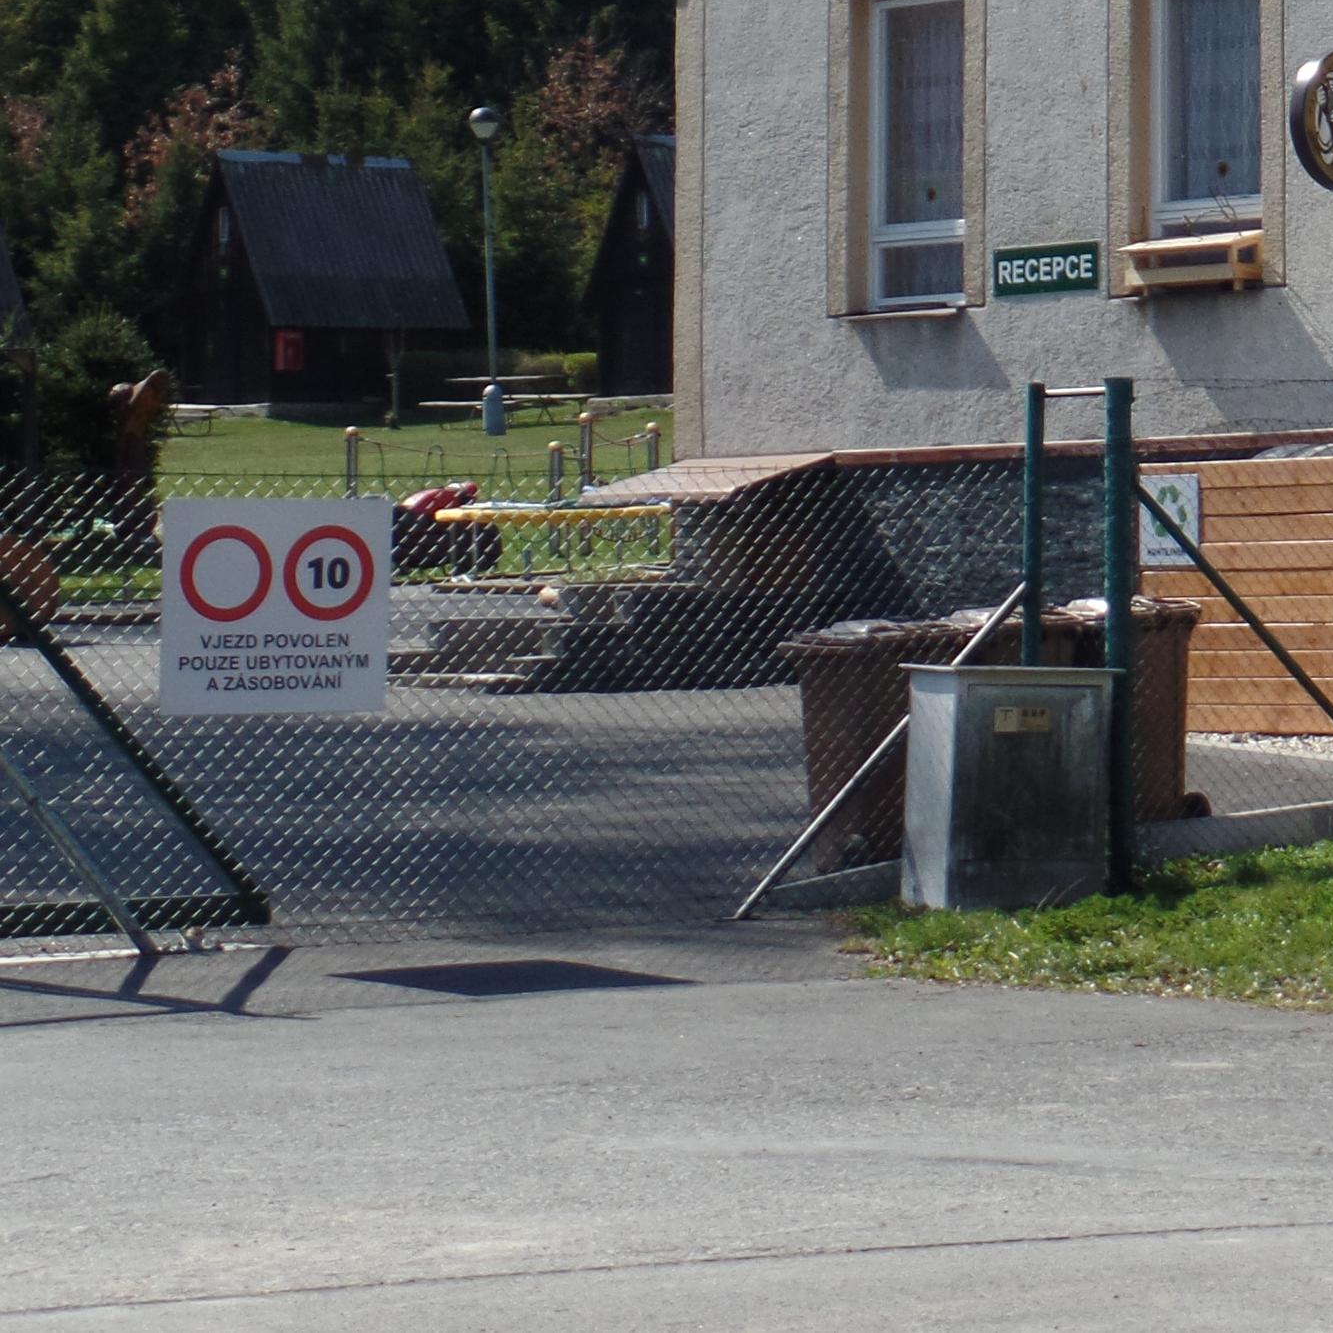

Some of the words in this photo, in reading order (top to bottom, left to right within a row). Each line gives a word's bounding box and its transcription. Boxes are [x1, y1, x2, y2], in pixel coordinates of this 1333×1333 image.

[998, 253, 1093, 284] RECEPCE
[308, 557, 350, 589] 10
[200, 634, 258, 649] VJEZD
[263, 633, 350, 649] POVOLEN
[178, 656, 240, 671] POUZE
[246, 651, 370, 670] UBYTOVANÝM
[206, 677, 219, 691] A
[223, 671, 343, 691] ZÁSOBOVÁNÍ
